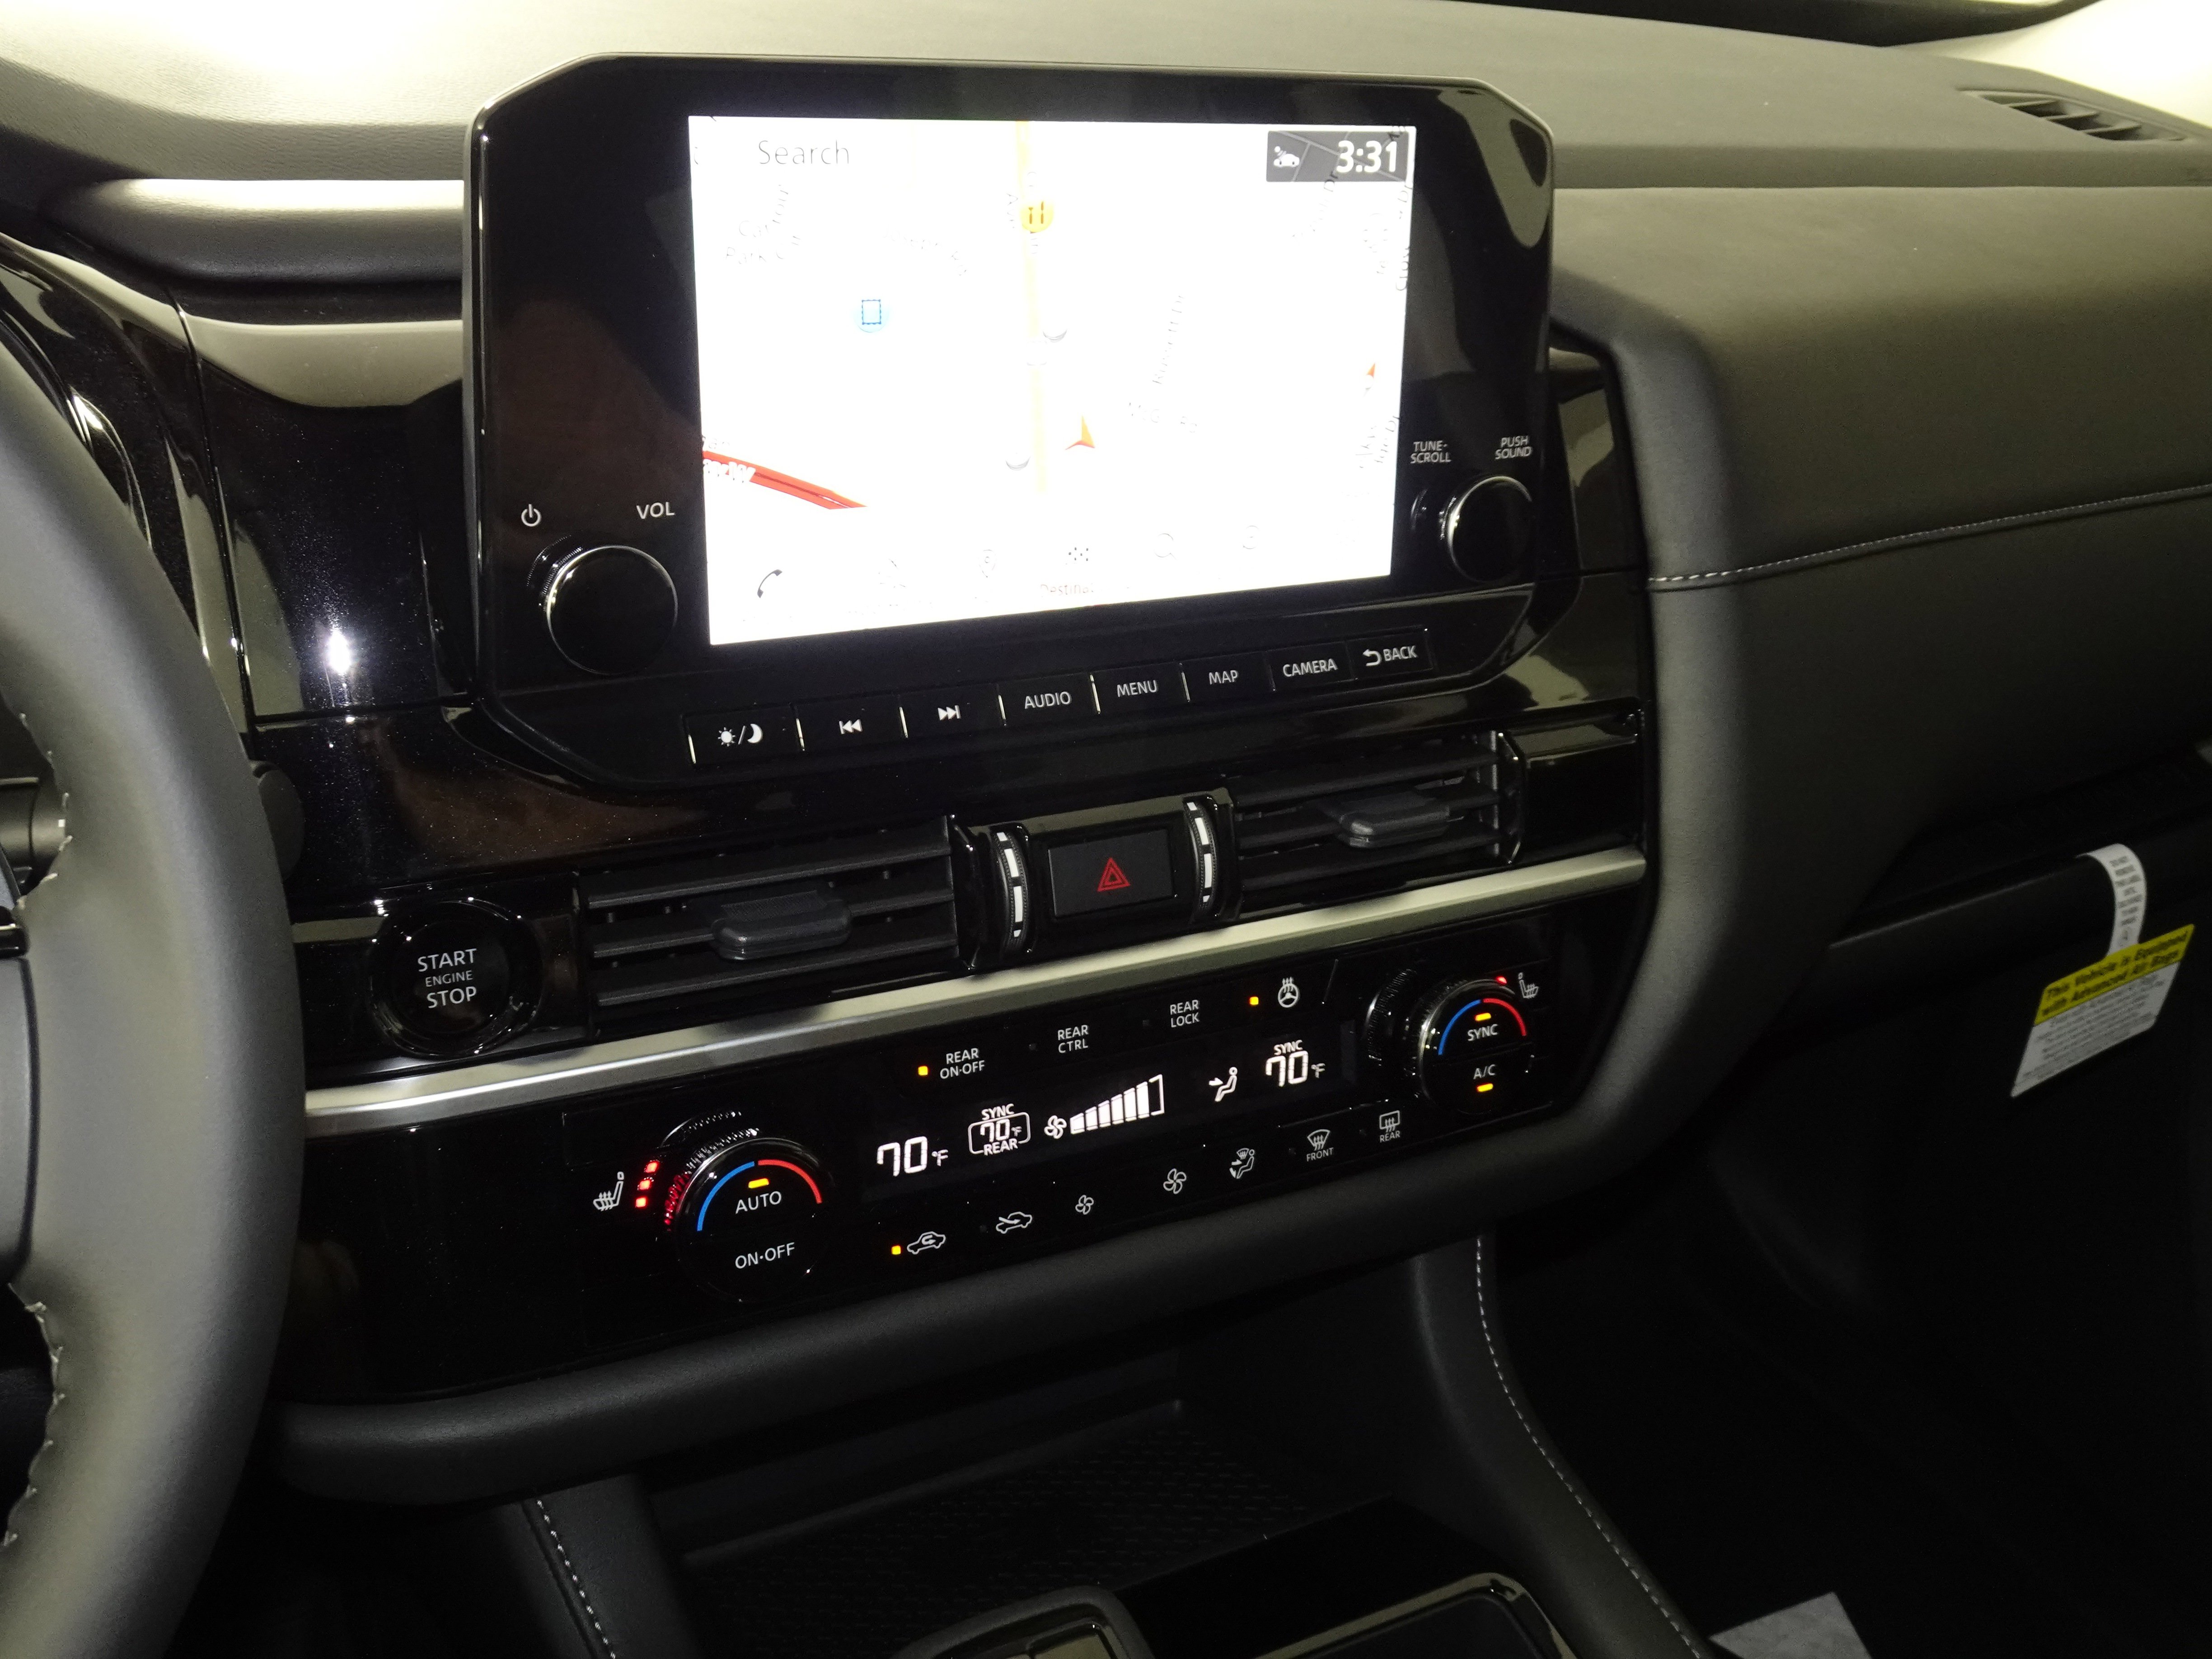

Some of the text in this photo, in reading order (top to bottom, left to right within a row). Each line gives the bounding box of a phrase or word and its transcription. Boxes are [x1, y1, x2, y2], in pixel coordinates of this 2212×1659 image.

[759, 140, 849, 165] Search
[1336, 140, 1397, 173] 3:31
[1500, 435, 1530, 448] PUSH
[1410, 452, 1452, 464] SCROLL
[1495, 446, 1532, 460] SOUND
[636, 501, 675, 520] VOL
[1382, 645, 1417, 661] BACK
[1283, 658, 1338, 677] CAMERA
[1209, 670, 1238, 685] MAP
[1117, 680, 1158, 698] MENU
[1024, 691, 1072, 709] AUDIO
[417, 948, 477, 972] START
[425, 970, 473, 987] ENGINE
[426, 986, 477, 1008] STOP
[1170, 999, 1200, 1015] REAR
[1170, 1012, 1200, 1028] LOCK
[1057, 1024, 1089, 1040] REAR
[1467, 1024, 1498, 1041] SYNC
[1058, 1038, 1089, 1053] CTRL
[1274, 1040, 1303, 1055] SYNC
[946, 1048, 979, 1065] REAR
[1473, 1064, 1496, 1080] A/C
[981, 1103, 1015, 1120] SYNC
[1379, 1130, 1401, 1143] REAR
[983, 1138, 1019, 1156] REAR
[1306, 1147, 1334, 1162] FRONT
[736, 1191, 782, 1214] AUTO
